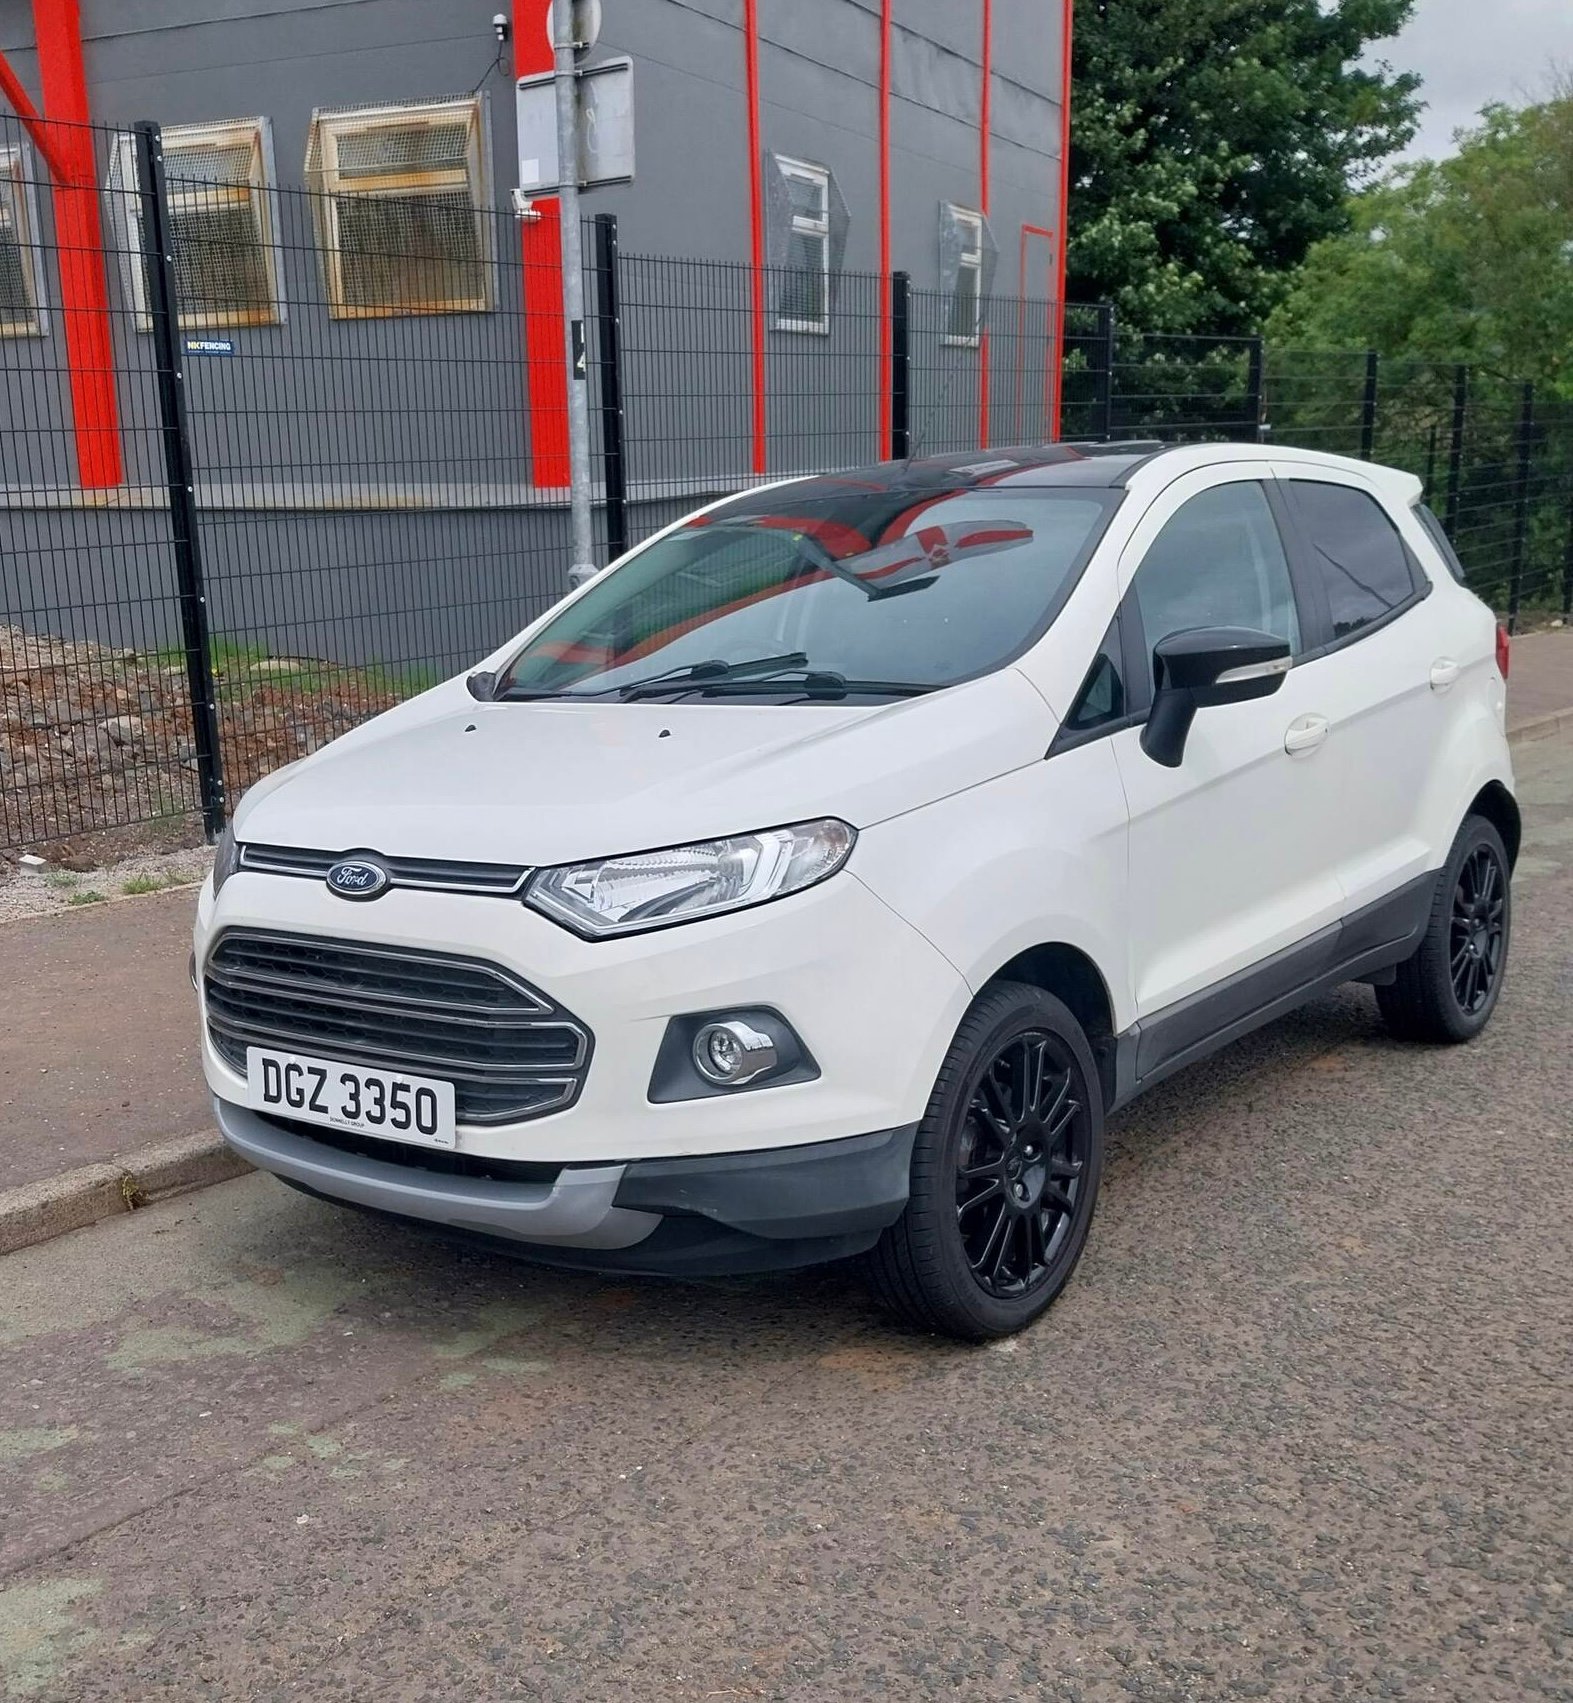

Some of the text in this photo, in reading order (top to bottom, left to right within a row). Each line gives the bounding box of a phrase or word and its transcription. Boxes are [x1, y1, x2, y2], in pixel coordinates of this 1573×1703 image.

[336, 866, 369, 886] Ford
[262, 1057, 438, 1135] DGZ 3350
[350, 1120, 365, 1129] GROUP
